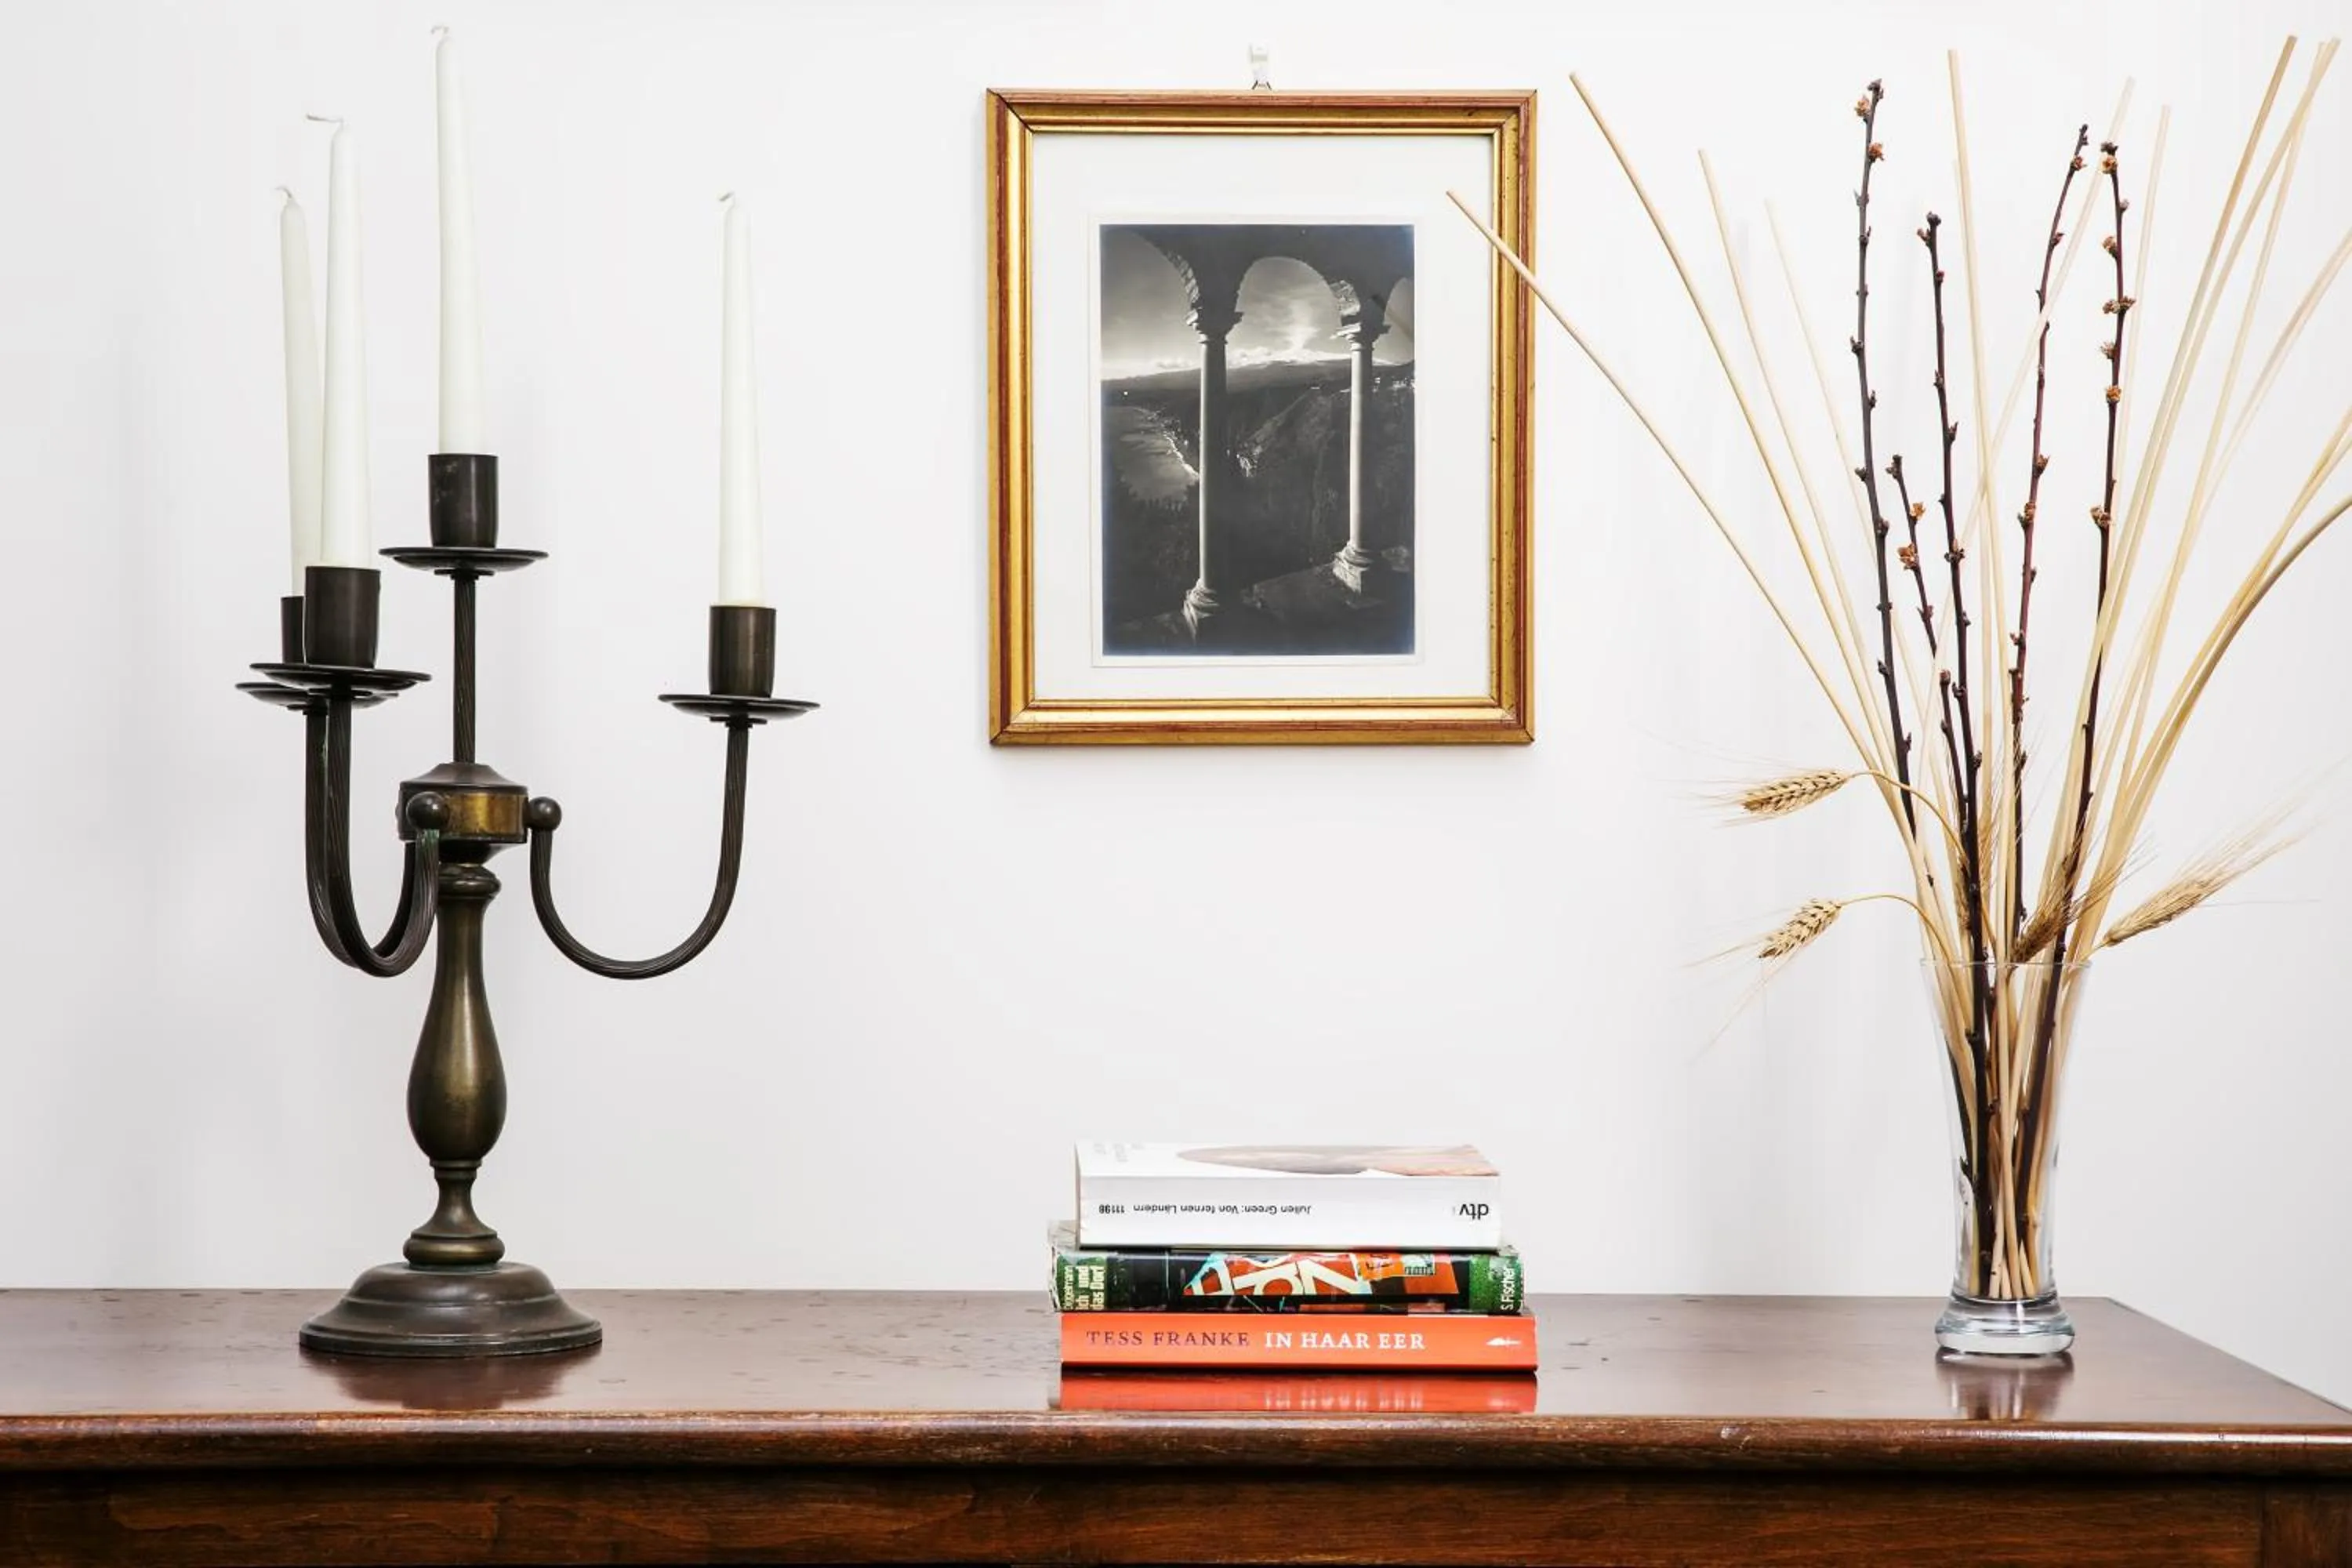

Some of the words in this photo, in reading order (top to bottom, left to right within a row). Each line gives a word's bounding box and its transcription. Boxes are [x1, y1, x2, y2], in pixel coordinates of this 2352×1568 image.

[1098, 1204, 1125, 1214] 11198
[1133, 1204, 1177, 1214] Ländern
[1180, 1204, 1216, 1214] fernen
[1219, 1204, 1239, 1214] Von
[1241, 1204, 1277, 1214] Green:
[1281, 1204, 1312, 1214] Julien
[1459, 1203, 1489, 1220] dtv
[1075, 1265, 1089, 1288] und
[1090, 1265, 1105, 1290] Dorf
[1090, 1290, 1105, 1310] das
[1086, 1330, 1142, 1346] TESS
[1153, 1330, 1250, 1347] FRANKE
[1265, 1331, 1293, 1348] IN
[1301, 1331, 1370, 1349] HAAR
[1378, 1332, 1426, 1350] EER
